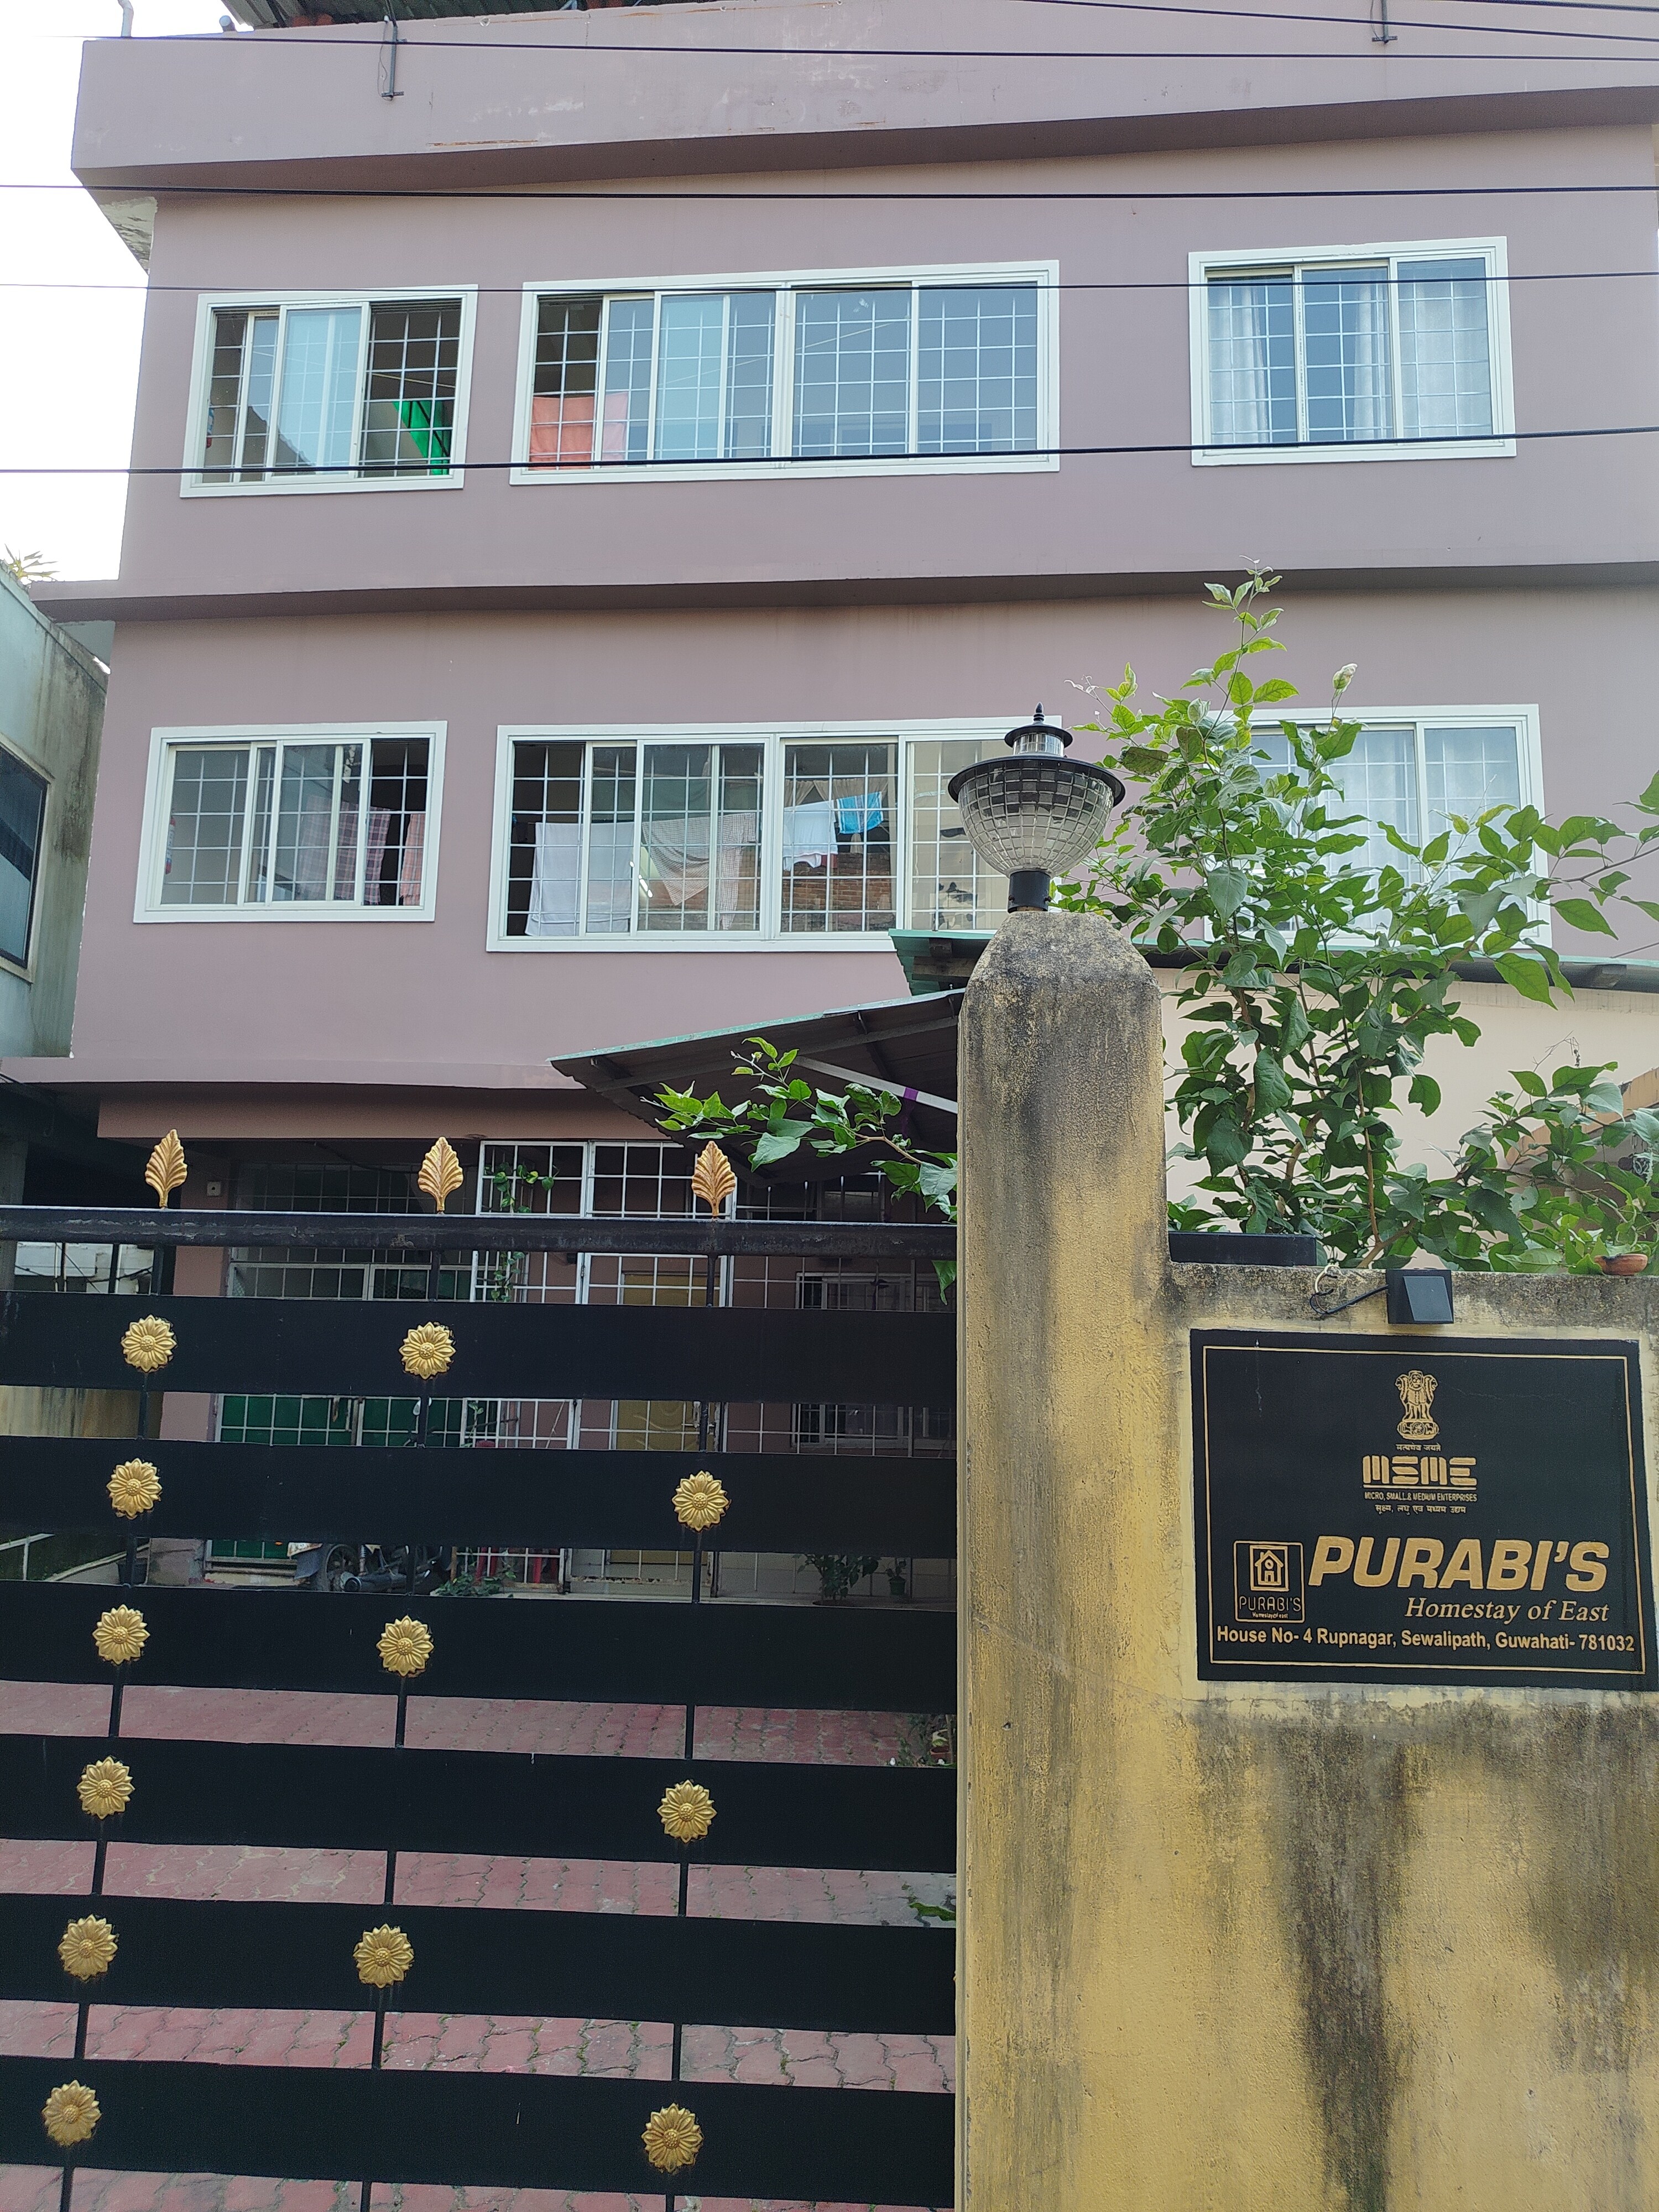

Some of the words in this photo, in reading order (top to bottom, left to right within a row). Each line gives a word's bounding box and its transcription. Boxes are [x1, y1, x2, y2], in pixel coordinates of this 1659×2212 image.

[1363, 1455, 1477, 1485] MSME
[1364, 1491, 1385, 1501] MICRO,
[1413, 1493, 1436, 1501] MEDIUM
[1437, 1493, 1478, 1502] ENTERPRISES
[1308, 1535, 1609, 1592] PURABI'S
[1239, 1596, 1301, 1612] PURABI'S
[1405, 1597, 1521, 1625] Homestay
[1527, 1600, 1557, 1621] of
[1558, 1600, 1610, 1621] East
[1217, 1625, 1266, 1642] House
[1272, 1627, 1299, 1643] No-
[1303, 1627, 1313, 1644] 4
[1317, 1628, 1396, 1649] Rupnagar,
[1401, 1630, 1490, 1651] Sewalipath,
[1495, 1632, 1575, 1650] Guwahati-
[1579, 1634, 1635, 1652] 781032
